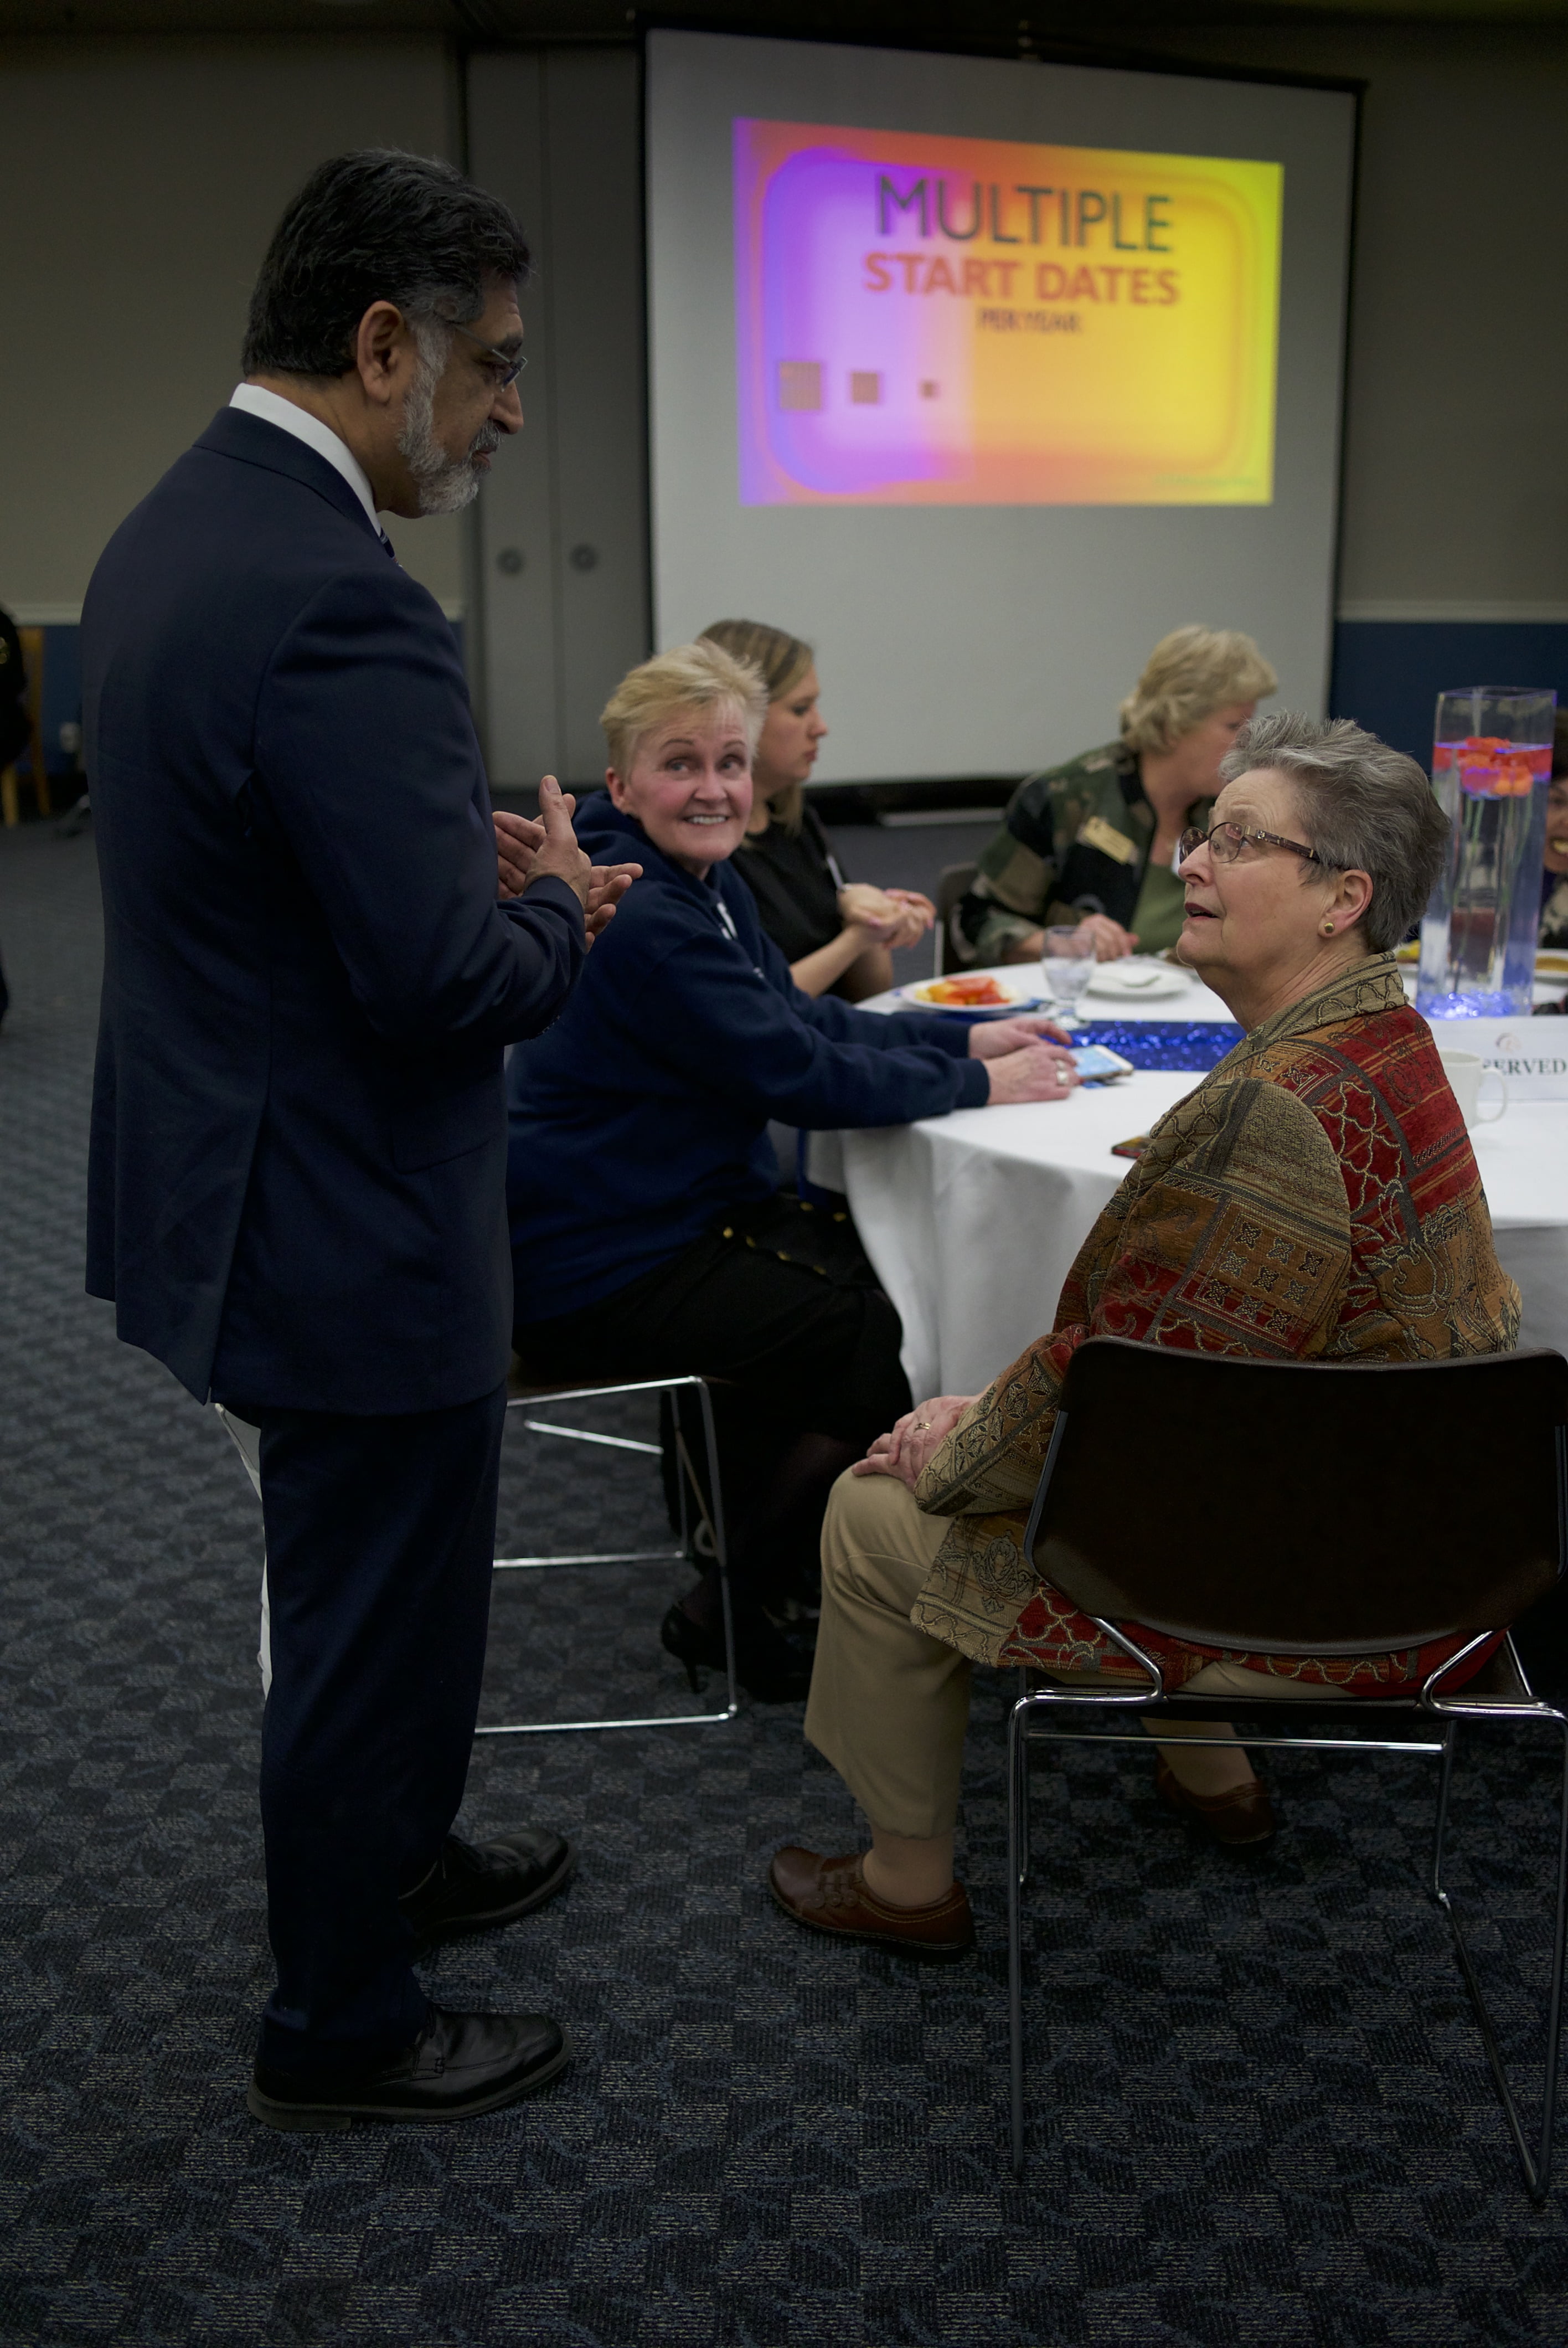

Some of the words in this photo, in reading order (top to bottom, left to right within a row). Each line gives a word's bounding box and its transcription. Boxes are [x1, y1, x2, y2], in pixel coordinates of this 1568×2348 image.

[878, 174, 1173, 253] MULTIPLE
[865, 251, 1020, 300] START
[1037, 262, 1179, 306] DATES
